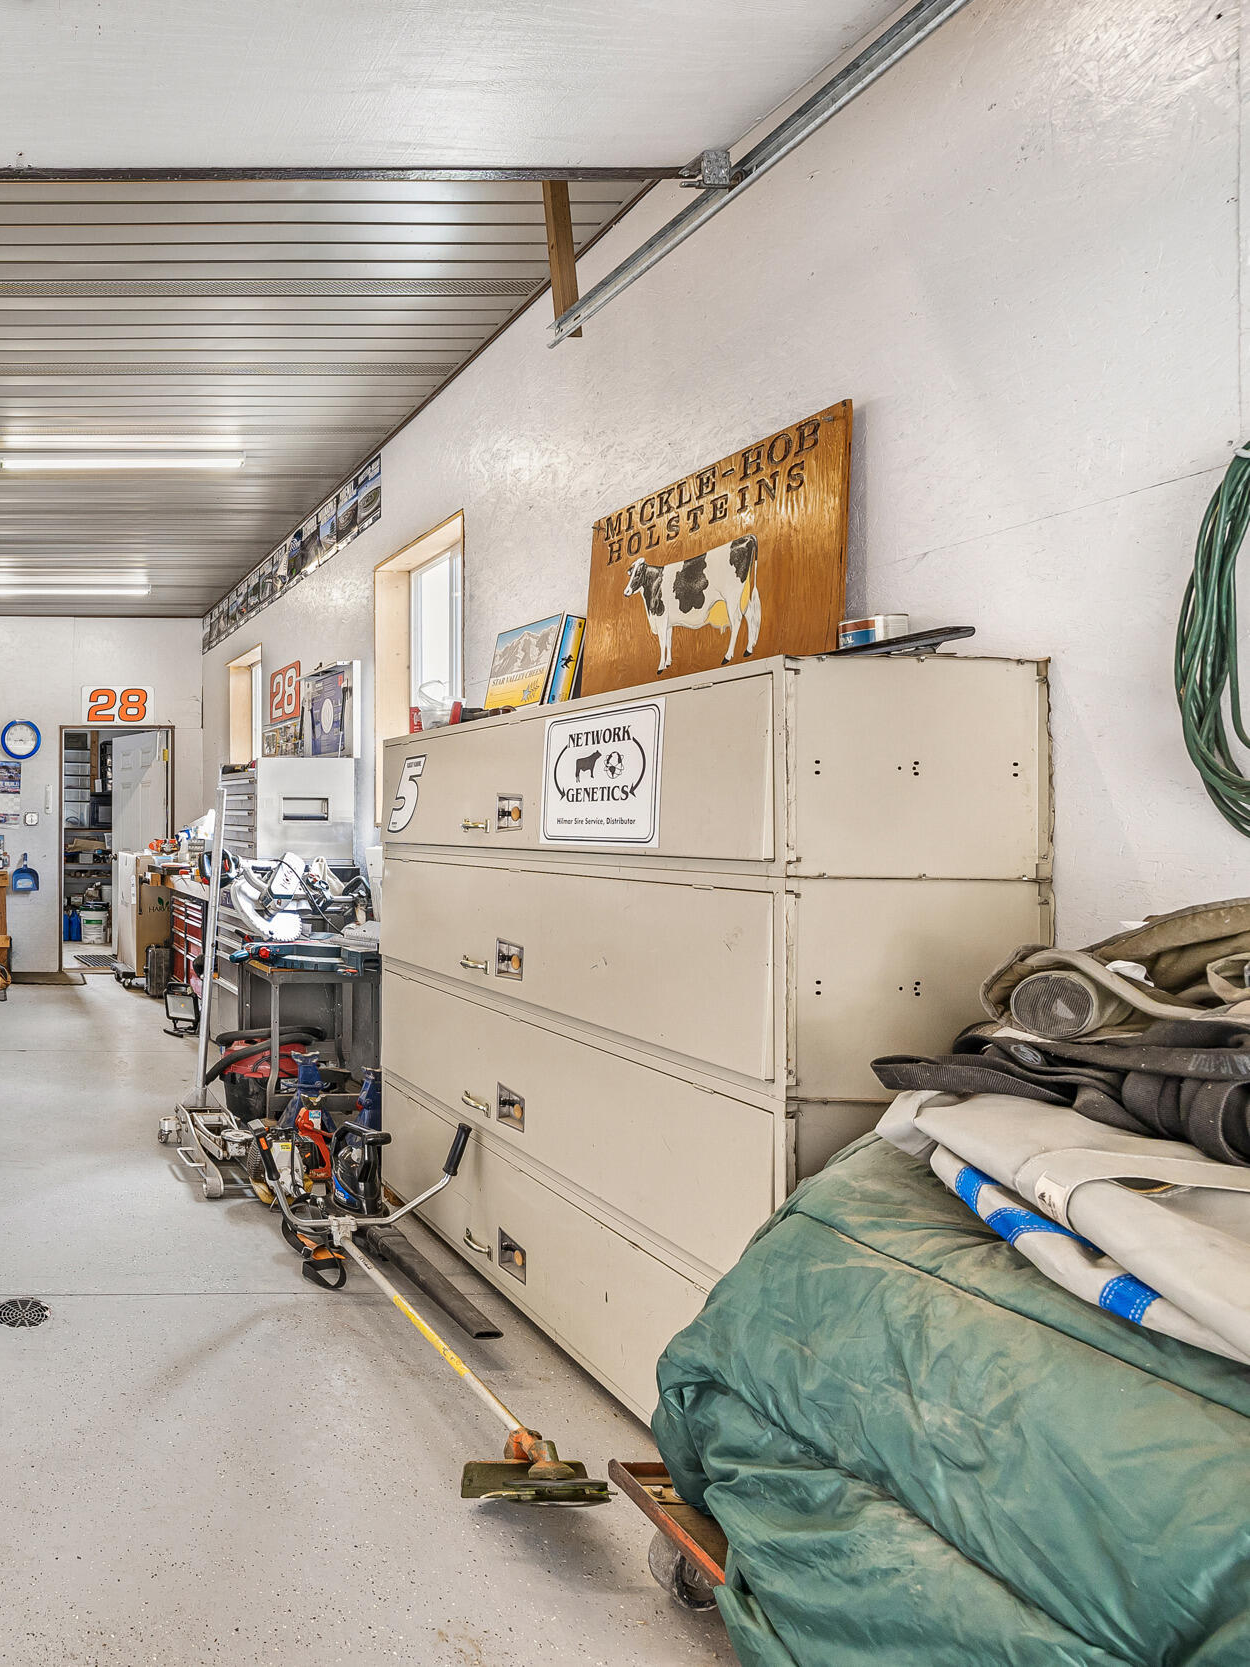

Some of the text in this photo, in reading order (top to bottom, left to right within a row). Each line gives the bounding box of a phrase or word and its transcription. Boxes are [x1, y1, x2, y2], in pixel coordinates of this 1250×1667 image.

[603, 419, 821, 542] MICKLE-HOB
[607, 460, 807, 566] HOLSTEINS
[86, 688, 148, 722] 28
[272, 667, 297, 719] 28
[568, 725, 632, 749] NETWORK
[387, 754, 428, 834] 5
[566, 784, 630, 803] GENETICS
[556, 817, 636, 826] Hilmar Sire Service, Distributor
